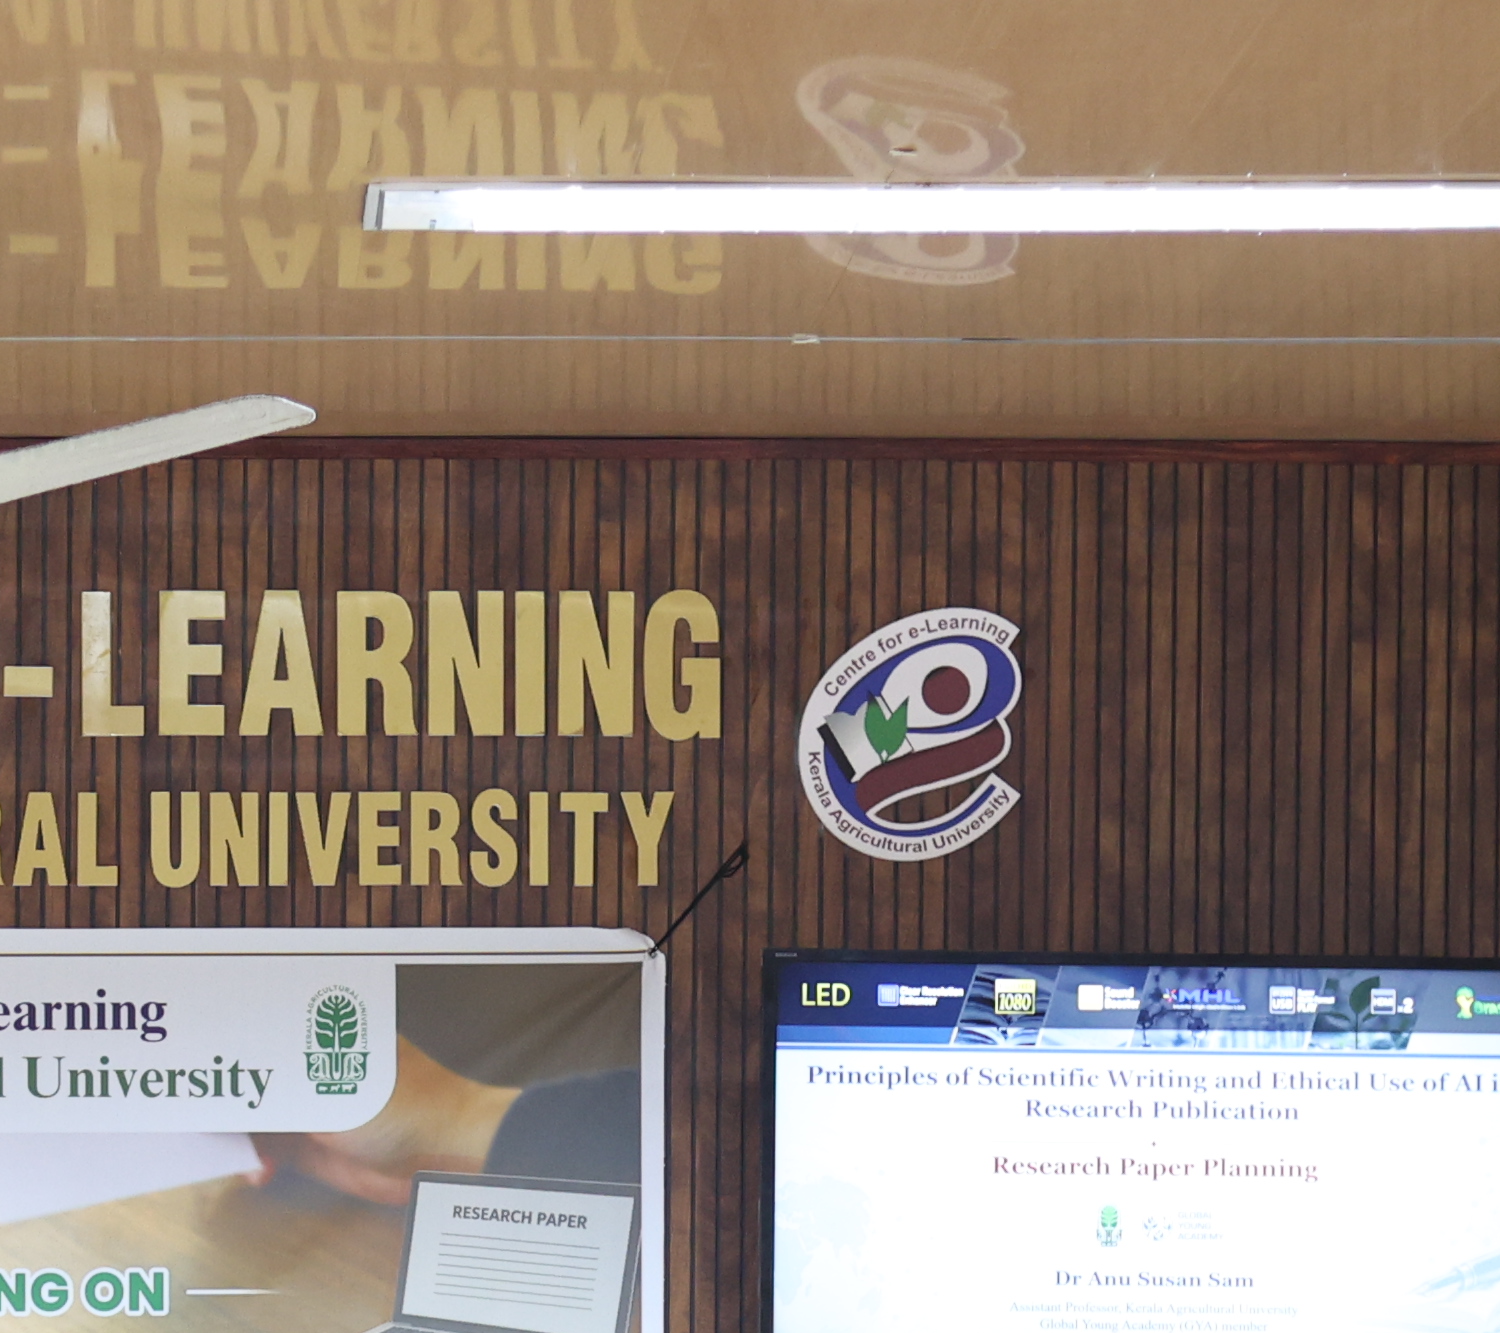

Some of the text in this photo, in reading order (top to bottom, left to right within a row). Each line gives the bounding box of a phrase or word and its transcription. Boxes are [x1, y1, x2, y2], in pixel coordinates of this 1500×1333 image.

[823, 616, 1011, 697] Centre for e-Learning
[807, 750, 1011, 853] Kerala Agricultural University
[149, 787, 675, 888] UNIVERSITY
[801, 982, 851, 1006] LED
[1000, 993, 1032, 1011] 1080
[1178, 988, 1241, 1003] MHL
[305, 985, 368, 1050] KERALA AGRICULTURAL UNIVERSITY
[22, 1055, 274, 1109] University
[807, 1065, 938, 1090] Principles
[946, 1066, 973, 1087] of
[978, 1067, 1100, 1088] Scientific
[1108, 1069, 1207, 1093] Writing
[1215, 1070, 1262, 1090] and
[1271, 1071, 1360, 1091] Ethical
[1370, 1072, 1415, 1092] Use
[1423, 1072, 1450, 1092] of
[1454, 1073, 1484, 1093] AI
[1025, 1099, 1299, 1120] Research Publication
[992, 1156, 1319, 1183] Research Paper Planning
[452, 1205, 588, 1230] RESEARCH PAPER
[84, 1271, 165, 1312] ON
[1055, 1270, 1255, 1288] Dr Anu Susan Sam
[1009, 1301, 1298, 1317] Assistant Professor, Kerala Agricultural University
[1039, 1318, 1268, 1333] Global Young Academy (GYA) member
